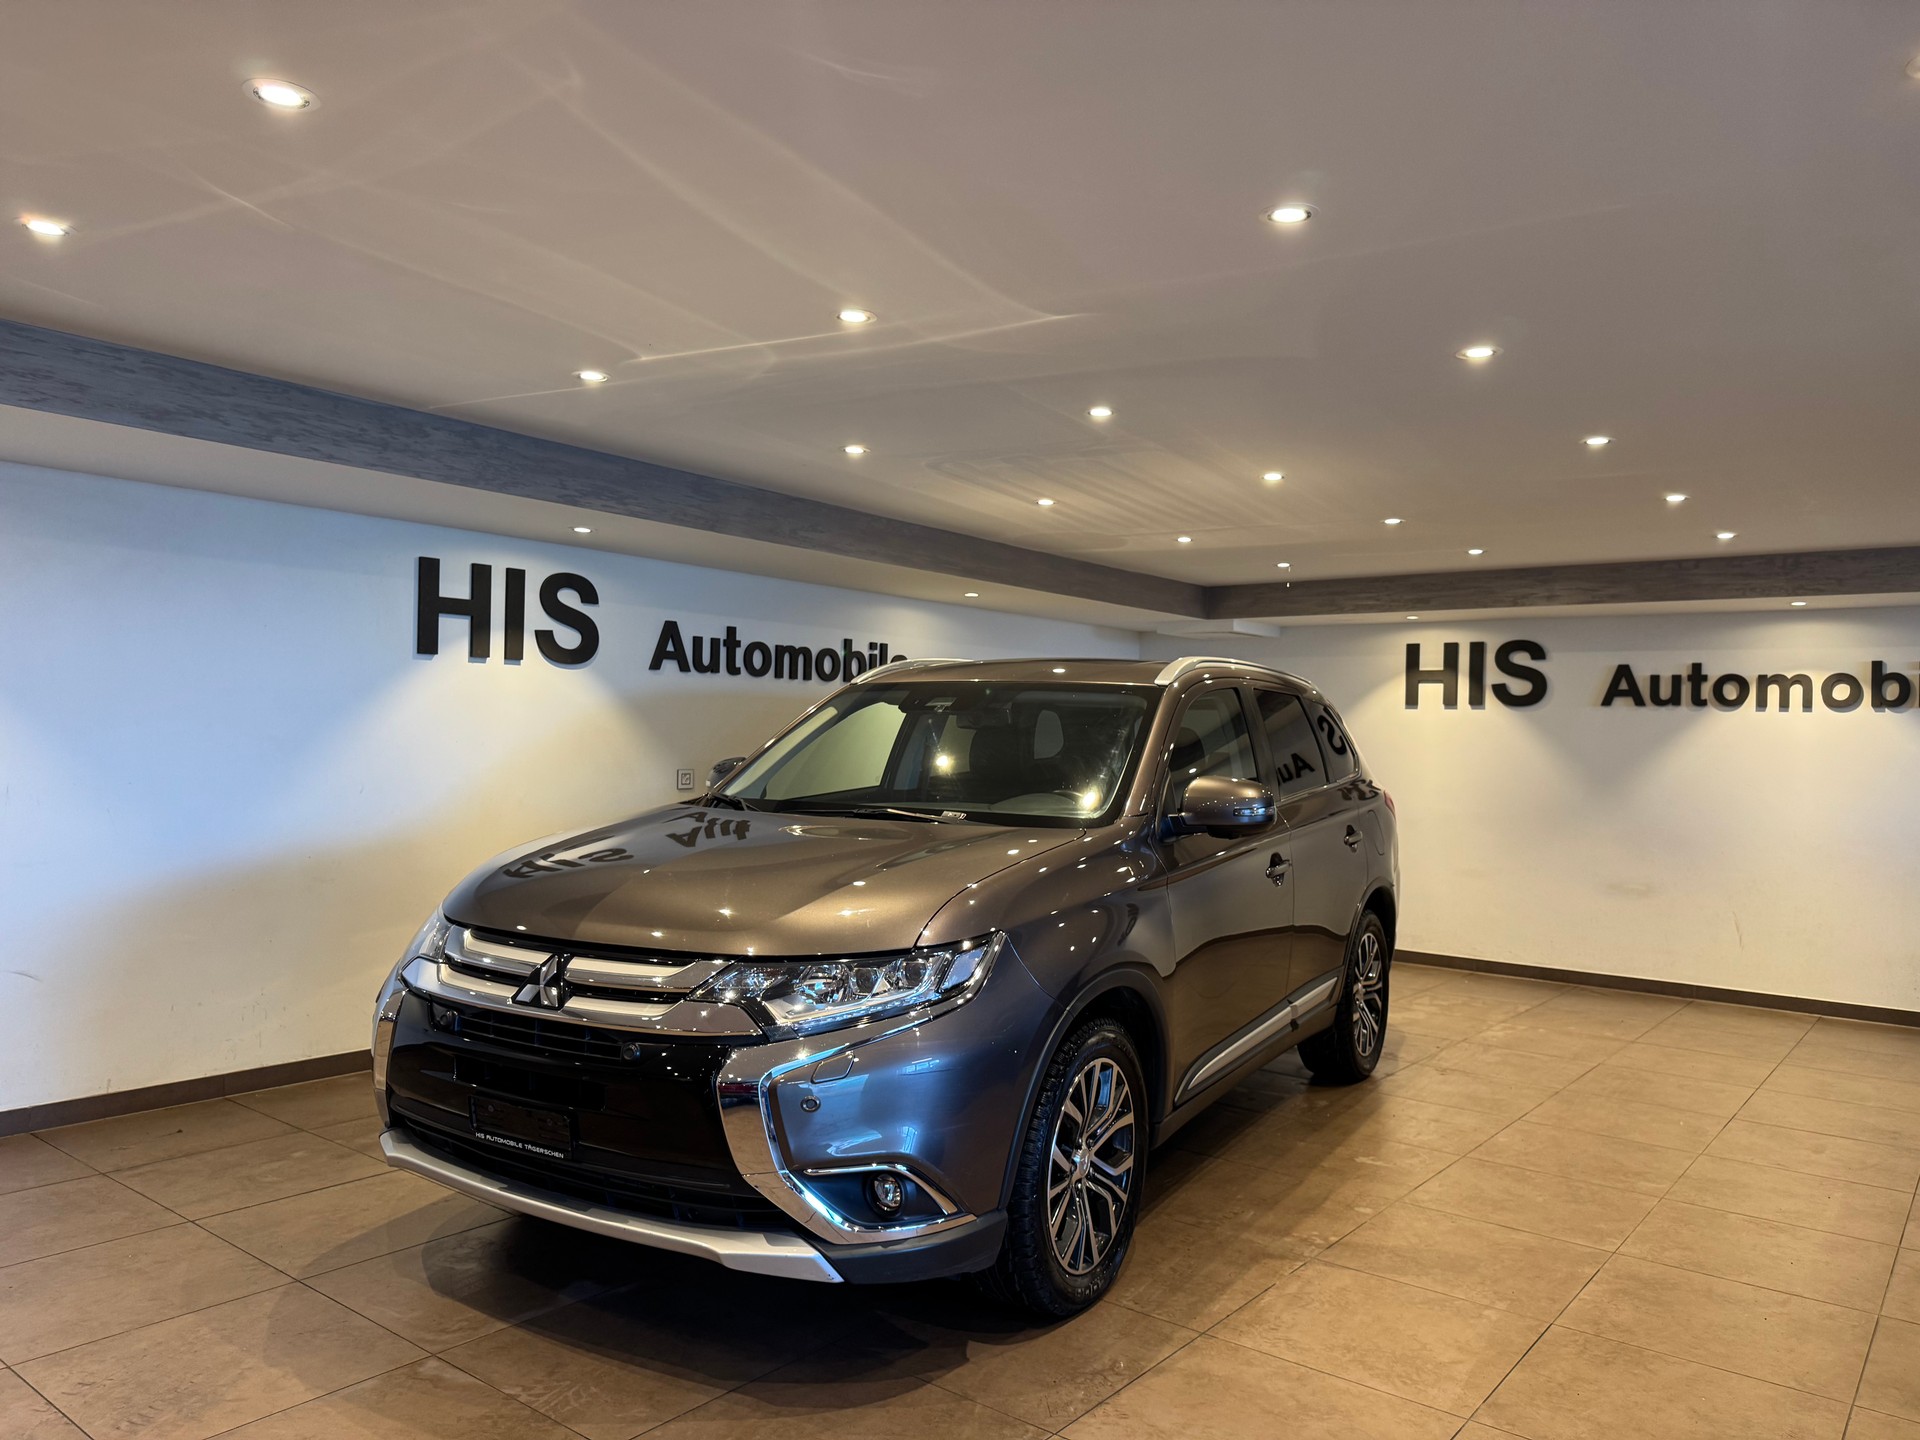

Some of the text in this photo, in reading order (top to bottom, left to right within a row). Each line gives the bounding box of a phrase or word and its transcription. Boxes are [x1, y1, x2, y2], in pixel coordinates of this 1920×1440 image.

[416, 556, 600, 664] HIS
[1405, 640, 1920, 710] HIS Automob
[486, 1134, 523, 1149] AUTOMOBILE
